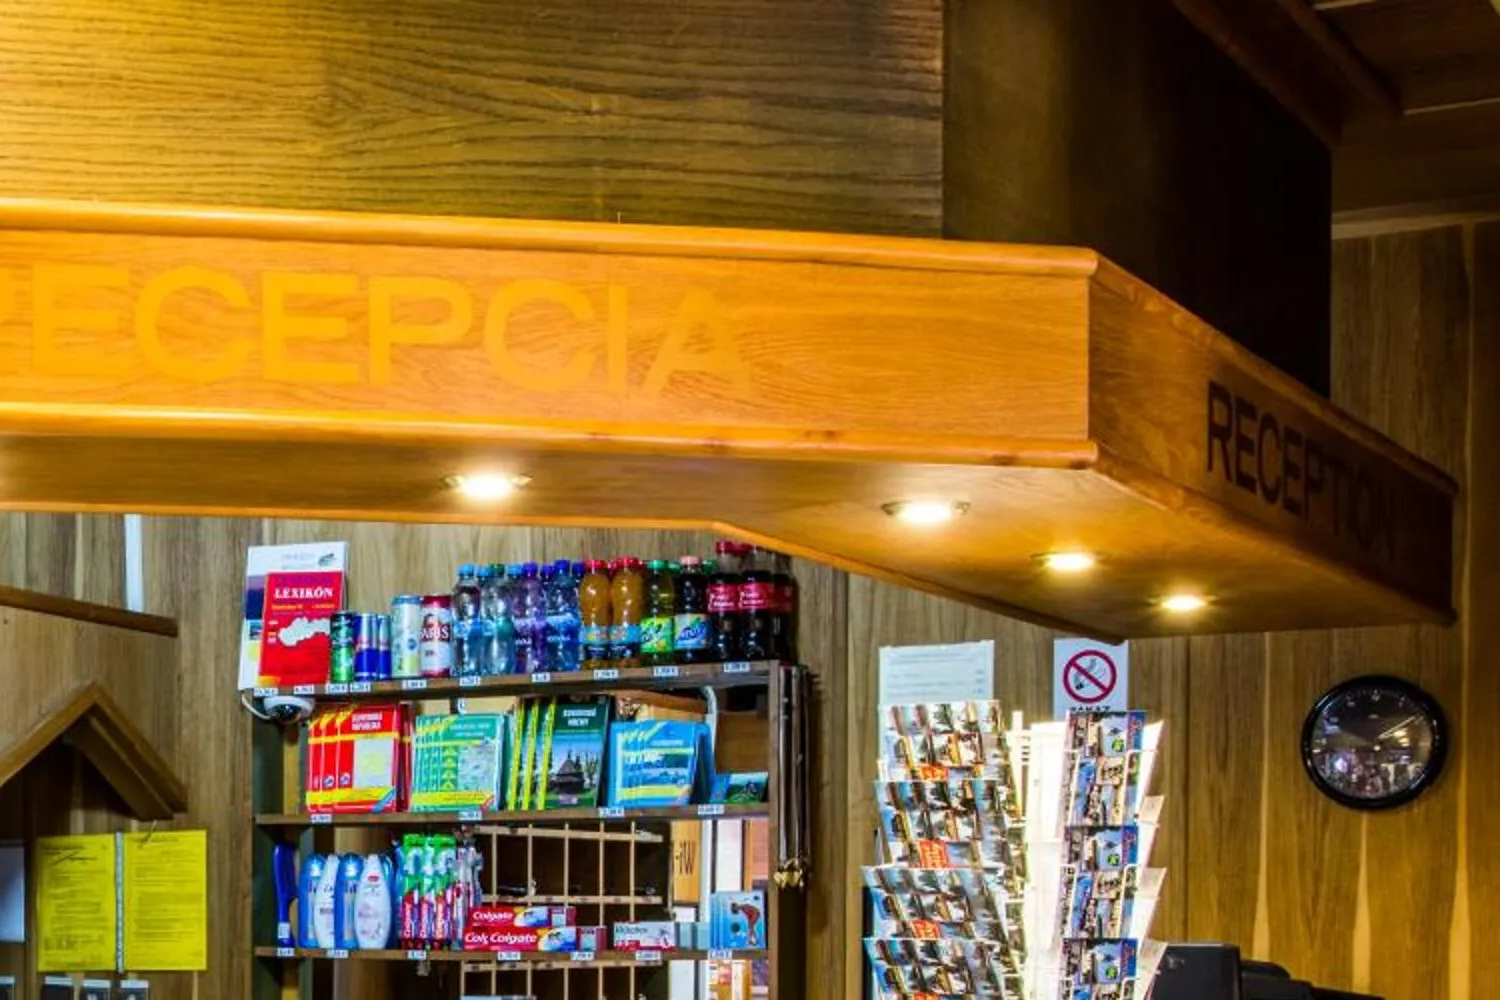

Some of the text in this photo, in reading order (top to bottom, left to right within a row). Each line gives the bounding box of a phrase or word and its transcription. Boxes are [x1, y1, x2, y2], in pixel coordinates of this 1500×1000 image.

[1207, 381, 1396, 563] RECEPTION
[274, 585, 334, 599] LEXIKÓN
[472, 911, 514, 922] Colgate
[489, 931, 538, 945] Colgate
